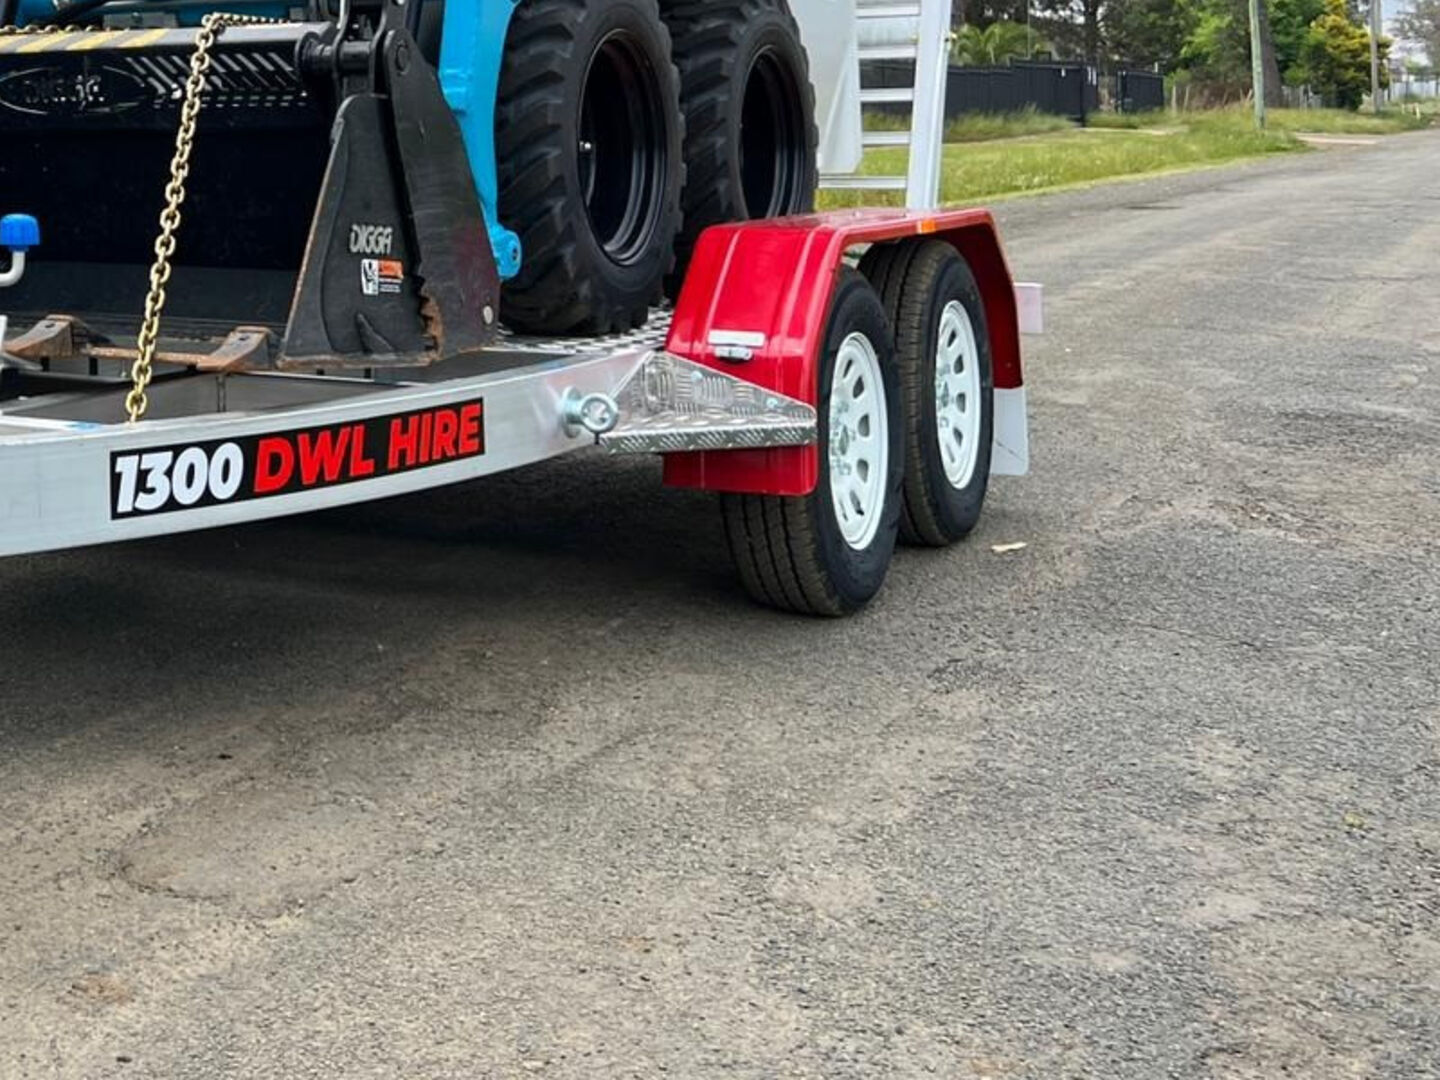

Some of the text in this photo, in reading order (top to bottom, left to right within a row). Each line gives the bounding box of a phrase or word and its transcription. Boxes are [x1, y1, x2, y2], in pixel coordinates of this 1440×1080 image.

[350, 223, 393, 254] DIGGA
[114, 402, 483, 514] 1300 DWL HIRE
